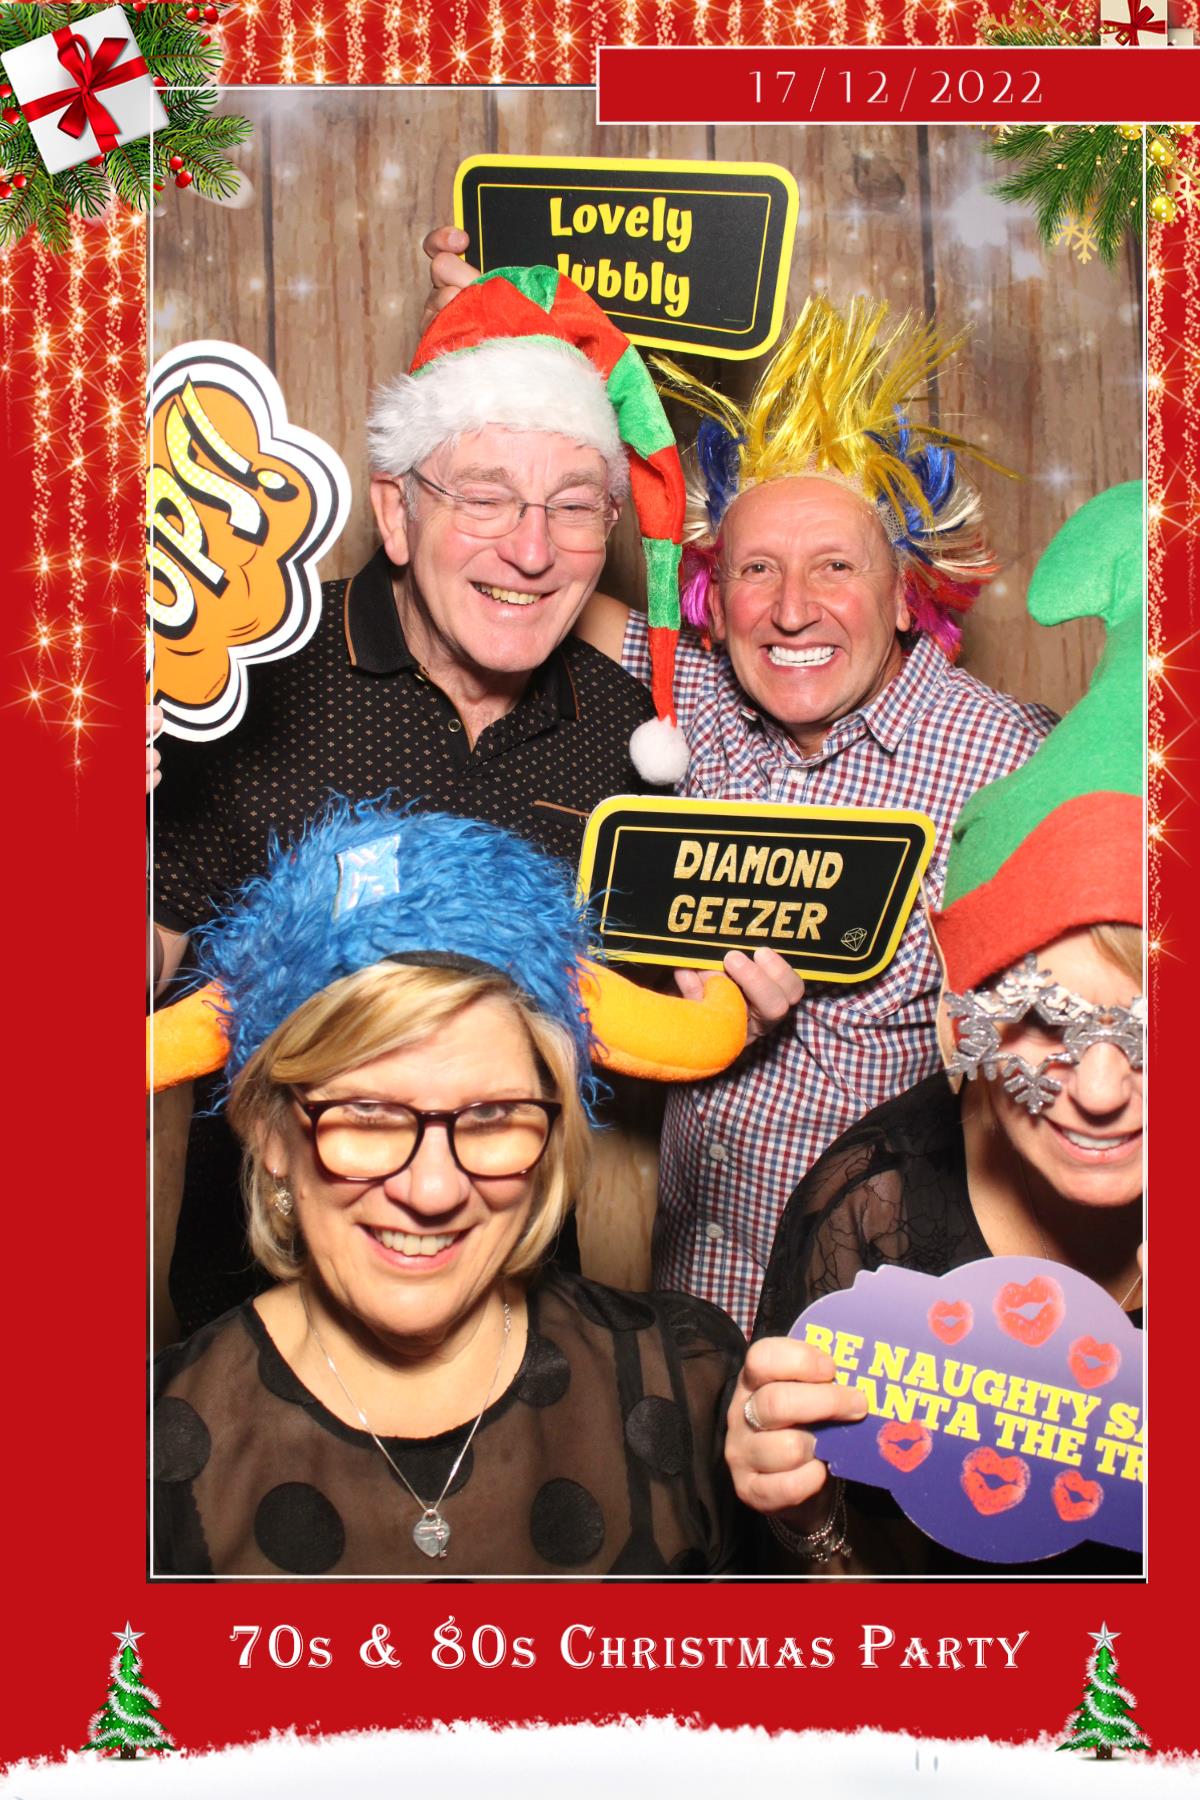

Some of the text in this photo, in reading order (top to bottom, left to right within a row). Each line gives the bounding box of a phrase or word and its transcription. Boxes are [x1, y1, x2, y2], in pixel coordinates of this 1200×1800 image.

[550, 196, 693, 253] Lovely
[146, 375, 288, 674] OPS!
[673, 839, 844, 889] DIAMOND
[667, 894, 828, 941] GEEZER
[805, 1323, 1144, 1444] BE NAUGHTY S
[834, 1370, 981, 1442] ANTA
[994, 1410, 1087, 1467] THE
